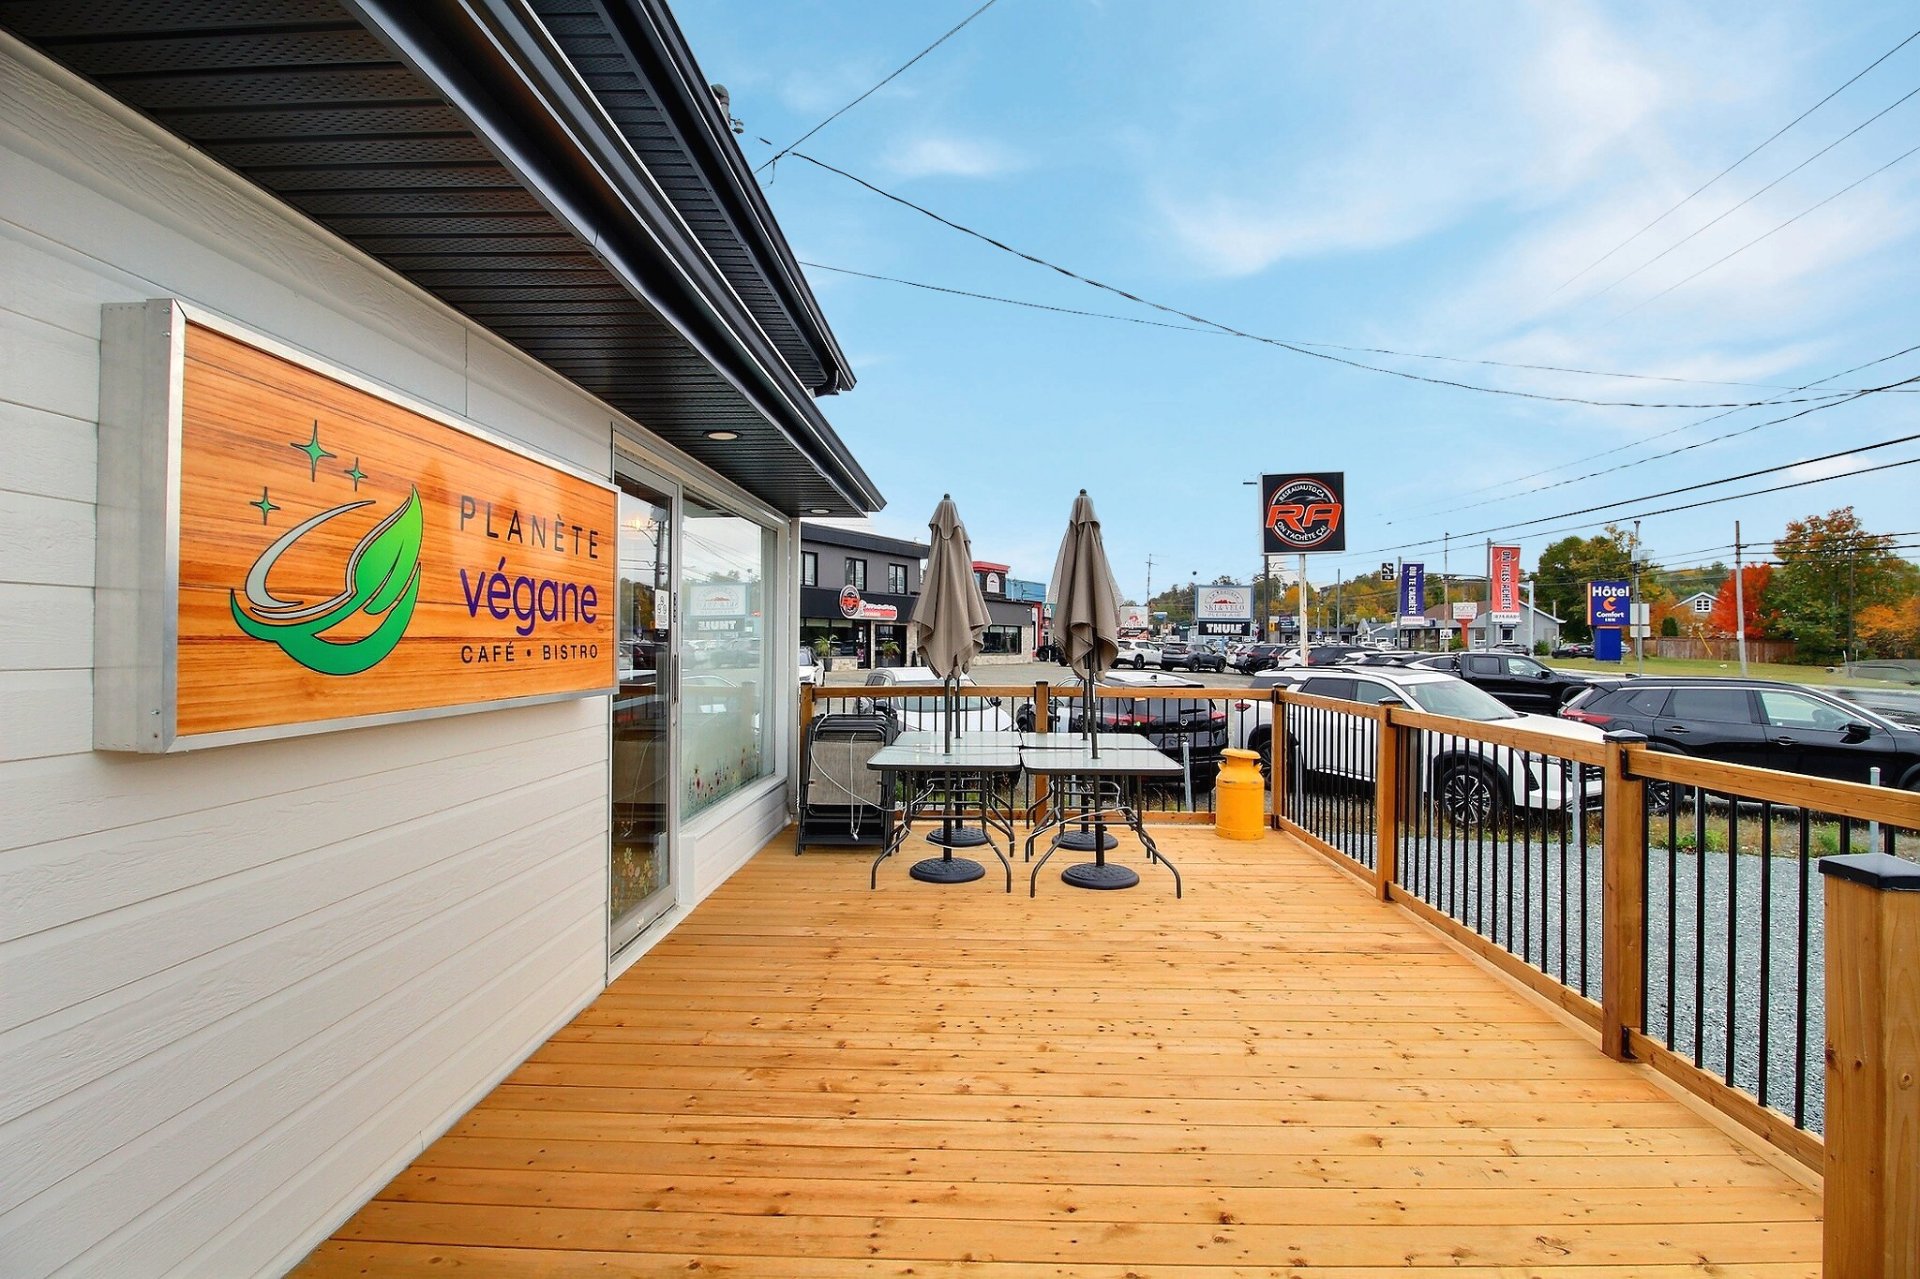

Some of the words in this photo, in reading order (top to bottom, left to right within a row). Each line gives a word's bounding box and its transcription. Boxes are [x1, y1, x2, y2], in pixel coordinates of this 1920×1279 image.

[460, 495, 599, 559] PLANÈTE
[1265, 503, 1342, 533] RA
[1277, 521, 1288, 532] ON
[459, 556, 598, 636] végane
[1592, 586, 1630, 597] Hôtel
[1206, 623, 1242, 634] THULE
[461, 641, 515, 663] CAFÉ
[543, 644, 598, 660] BISTRO
